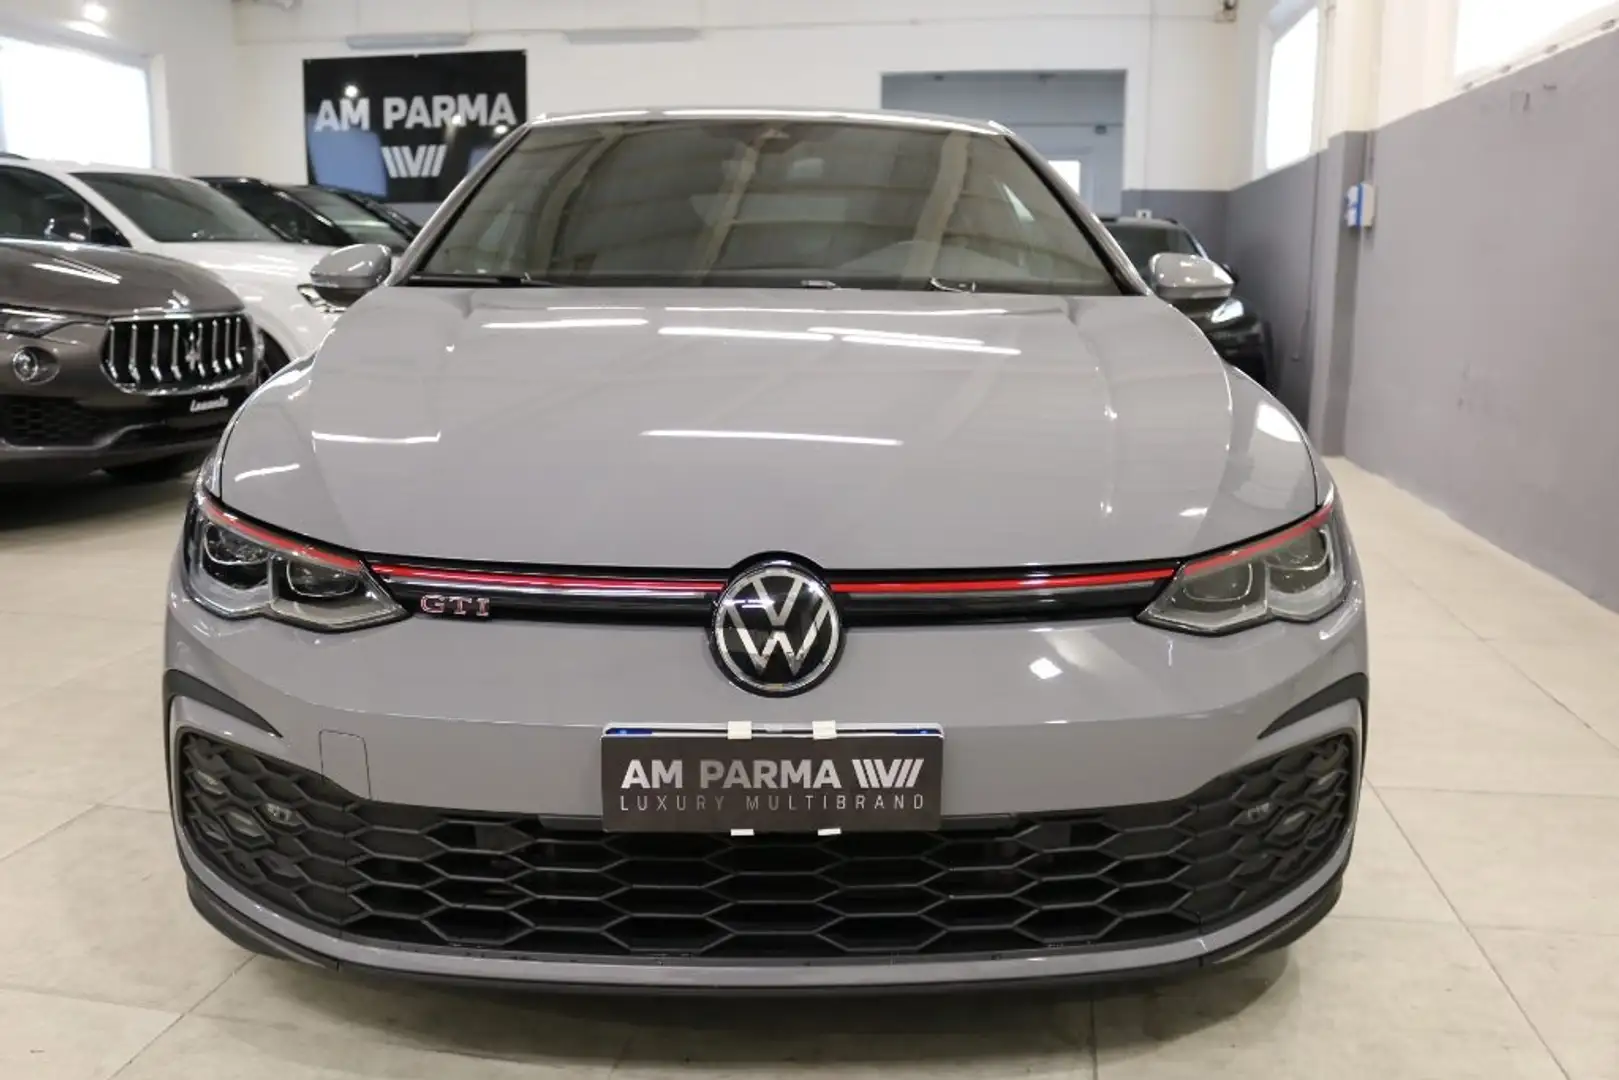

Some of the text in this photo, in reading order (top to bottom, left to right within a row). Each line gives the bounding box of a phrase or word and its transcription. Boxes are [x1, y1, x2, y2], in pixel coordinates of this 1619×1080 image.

[314, 92, 517, 133] AM PARMA
[420, 594, 490, 617] GTI
[620, 758, 843, 790] AM PARMA
[619, 793, 924, 811] LUXURY MULTIBRAND
